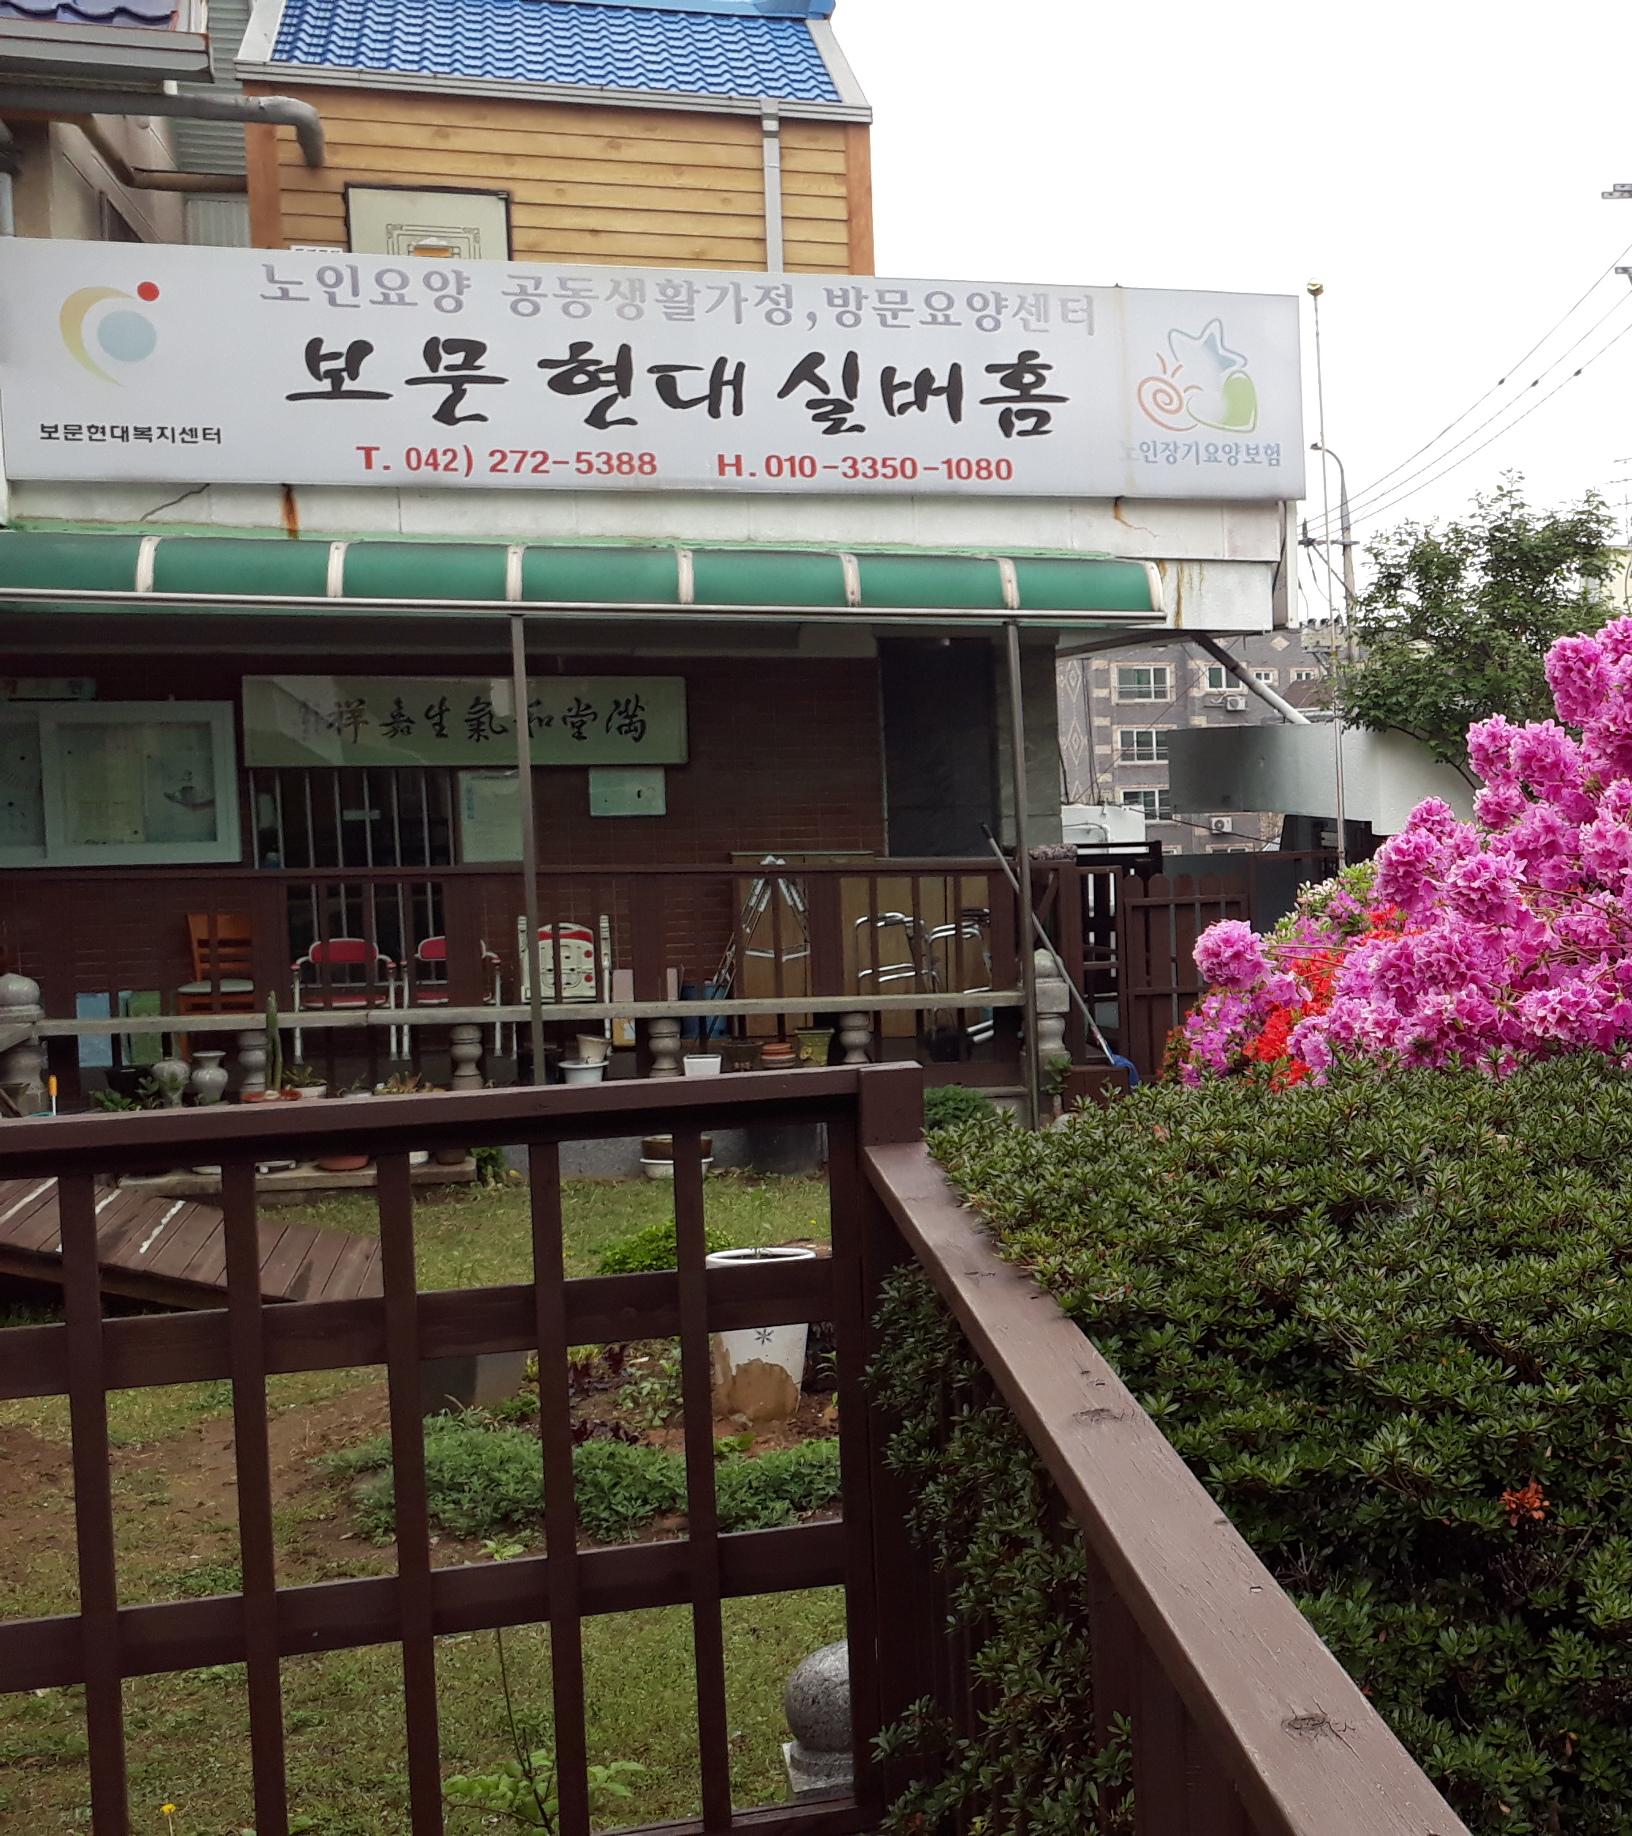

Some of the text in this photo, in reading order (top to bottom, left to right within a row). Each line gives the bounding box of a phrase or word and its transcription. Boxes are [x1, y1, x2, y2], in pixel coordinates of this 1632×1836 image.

[260, 263, 1096, 337] 노인요양 공동생활가정,방문요양센터
[285, 336, 1070, 439] 보문 현대 실버홈
[39, 422, 222, 445] 보문현대복지센터
[356, 446, 657, 476] T. 042) 272-5388
